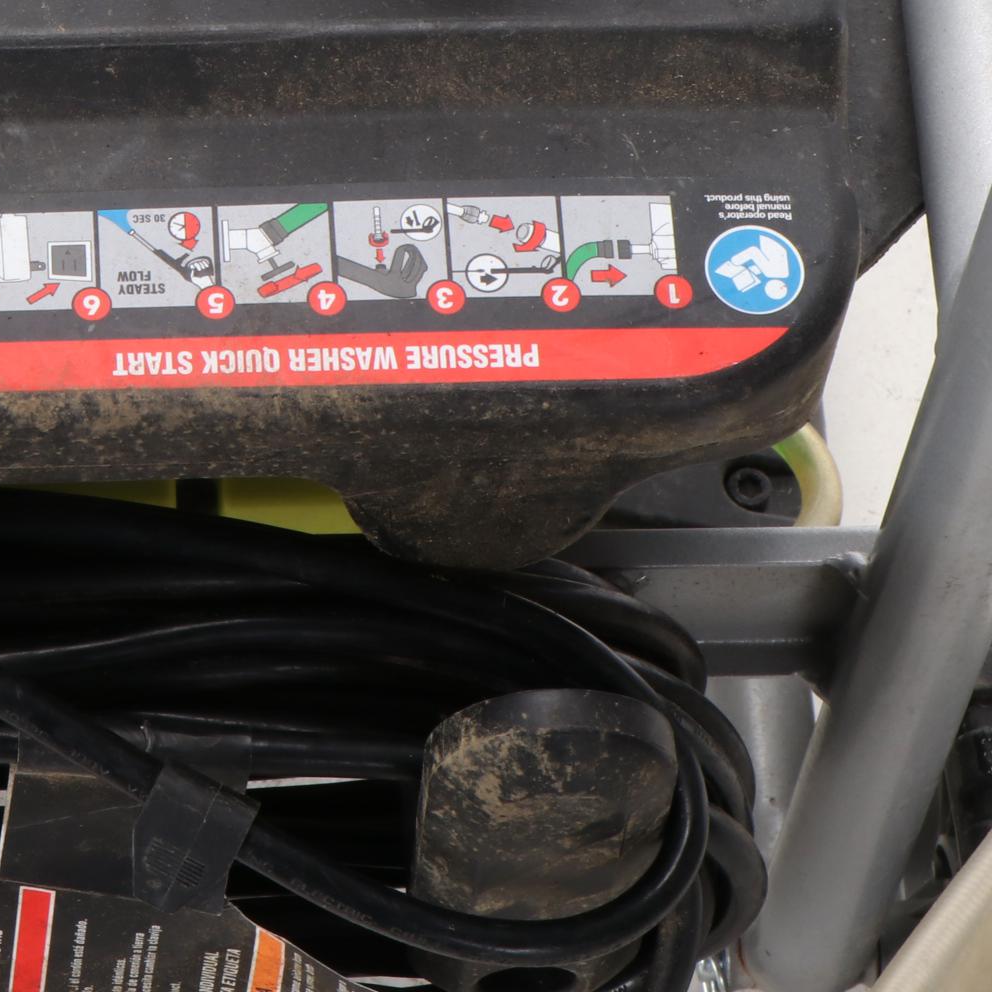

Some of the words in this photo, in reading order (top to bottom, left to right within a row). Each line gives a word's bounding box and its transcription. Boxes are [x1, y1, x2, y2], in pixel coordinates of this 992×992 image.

[704, 194, 743, 202] product.
[764, 193, 790, 202] using
[718, 211, 766, 220] operator's
[724, 204, 755, 212] before
[757, 204, 791, 212] manual
[768, 212, 792, 220] Read
[132, 214, 150, 223] SEC
[154, 214, 165, 222] 30
[118, 270, 151, 282] FLOW
[118, 283, 165, 294] STEADY
[552, 286, 568, 305] 2
[669, 284, 680, 303] 1
[83, 296, 100, 315] 6
[208, 294, 224, 312] 5
[318, 290, 336, 308] 4
[437, 289, 453, 308] 3
[112, 351, 192, 376] START
[202, 348, 280, 374] QUICK
[288, 346, 397, 372] WASHER
[406, 343, 540, 369] PRESSURE
[221, 949, 241, 986] ETIQUETA
